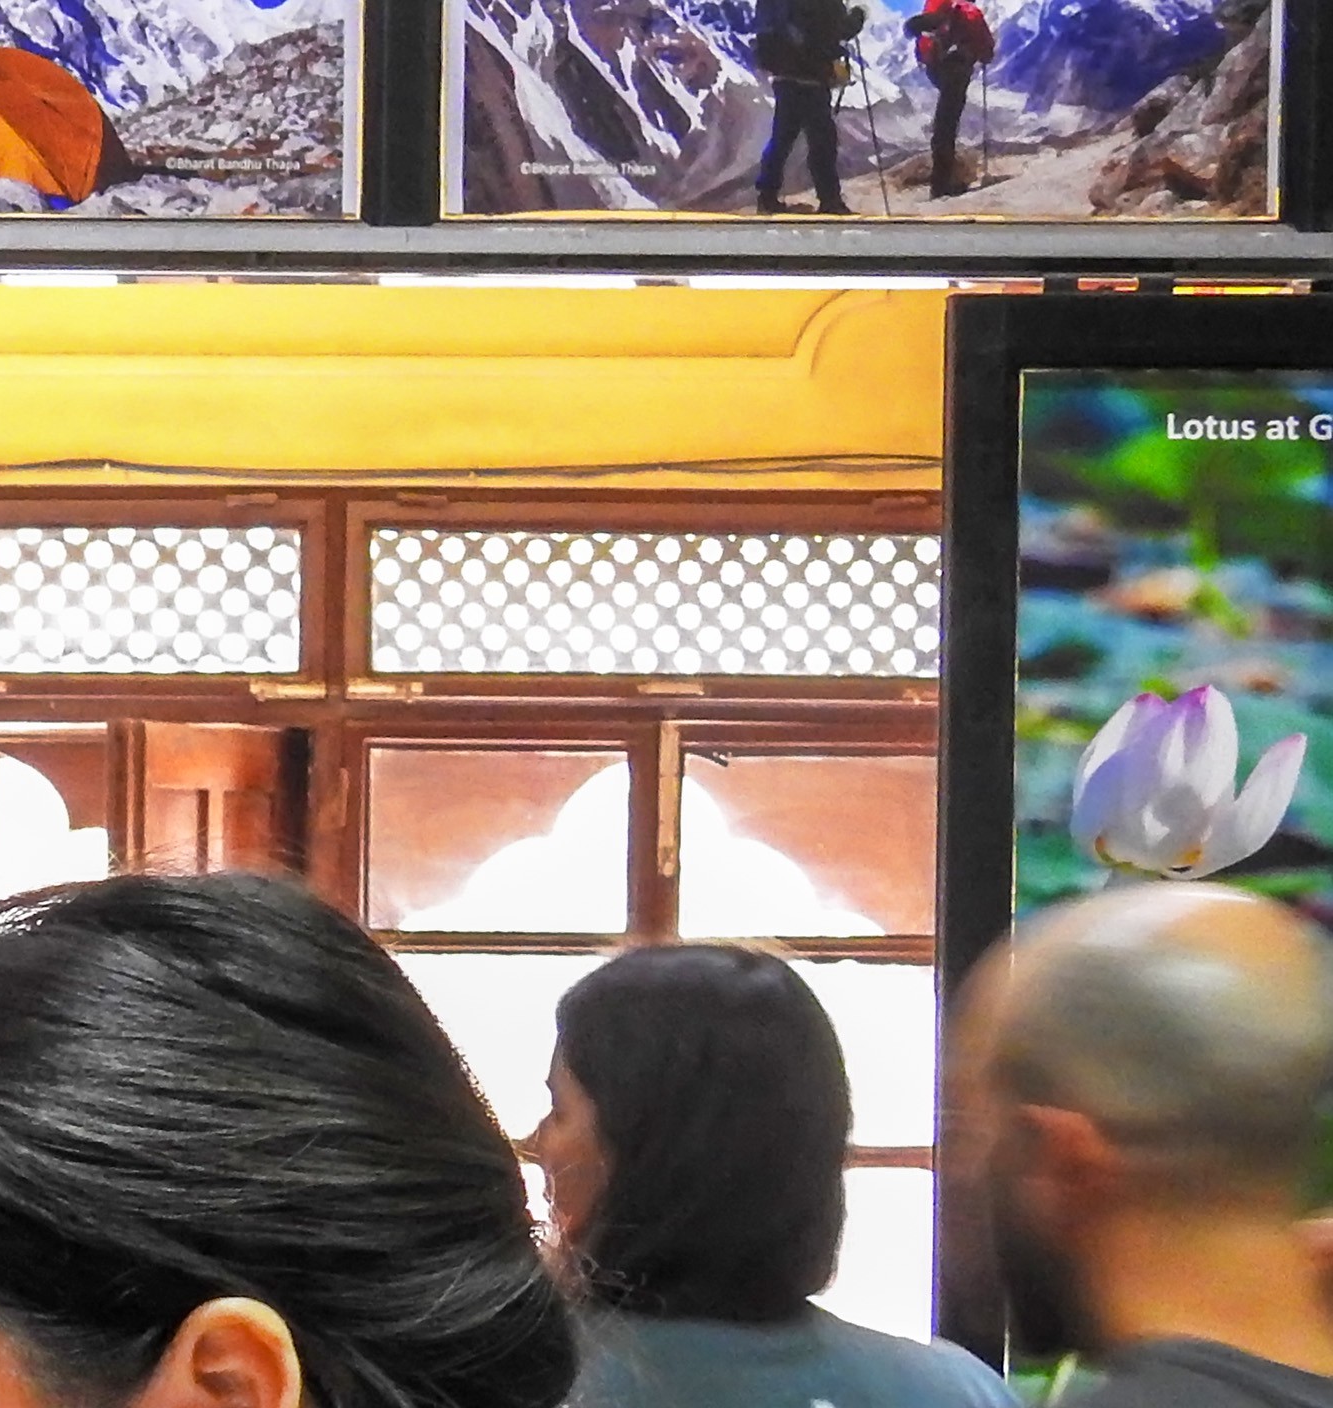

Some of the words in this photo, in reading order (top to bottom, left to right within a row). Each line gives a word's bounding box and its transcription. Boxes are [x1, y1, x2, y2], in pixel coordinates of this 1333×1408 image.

[265, 157, 300, 175] Thapa
[1166, 412, 1257, 441] Lotus
[1265, 415, 1300, 441] at
